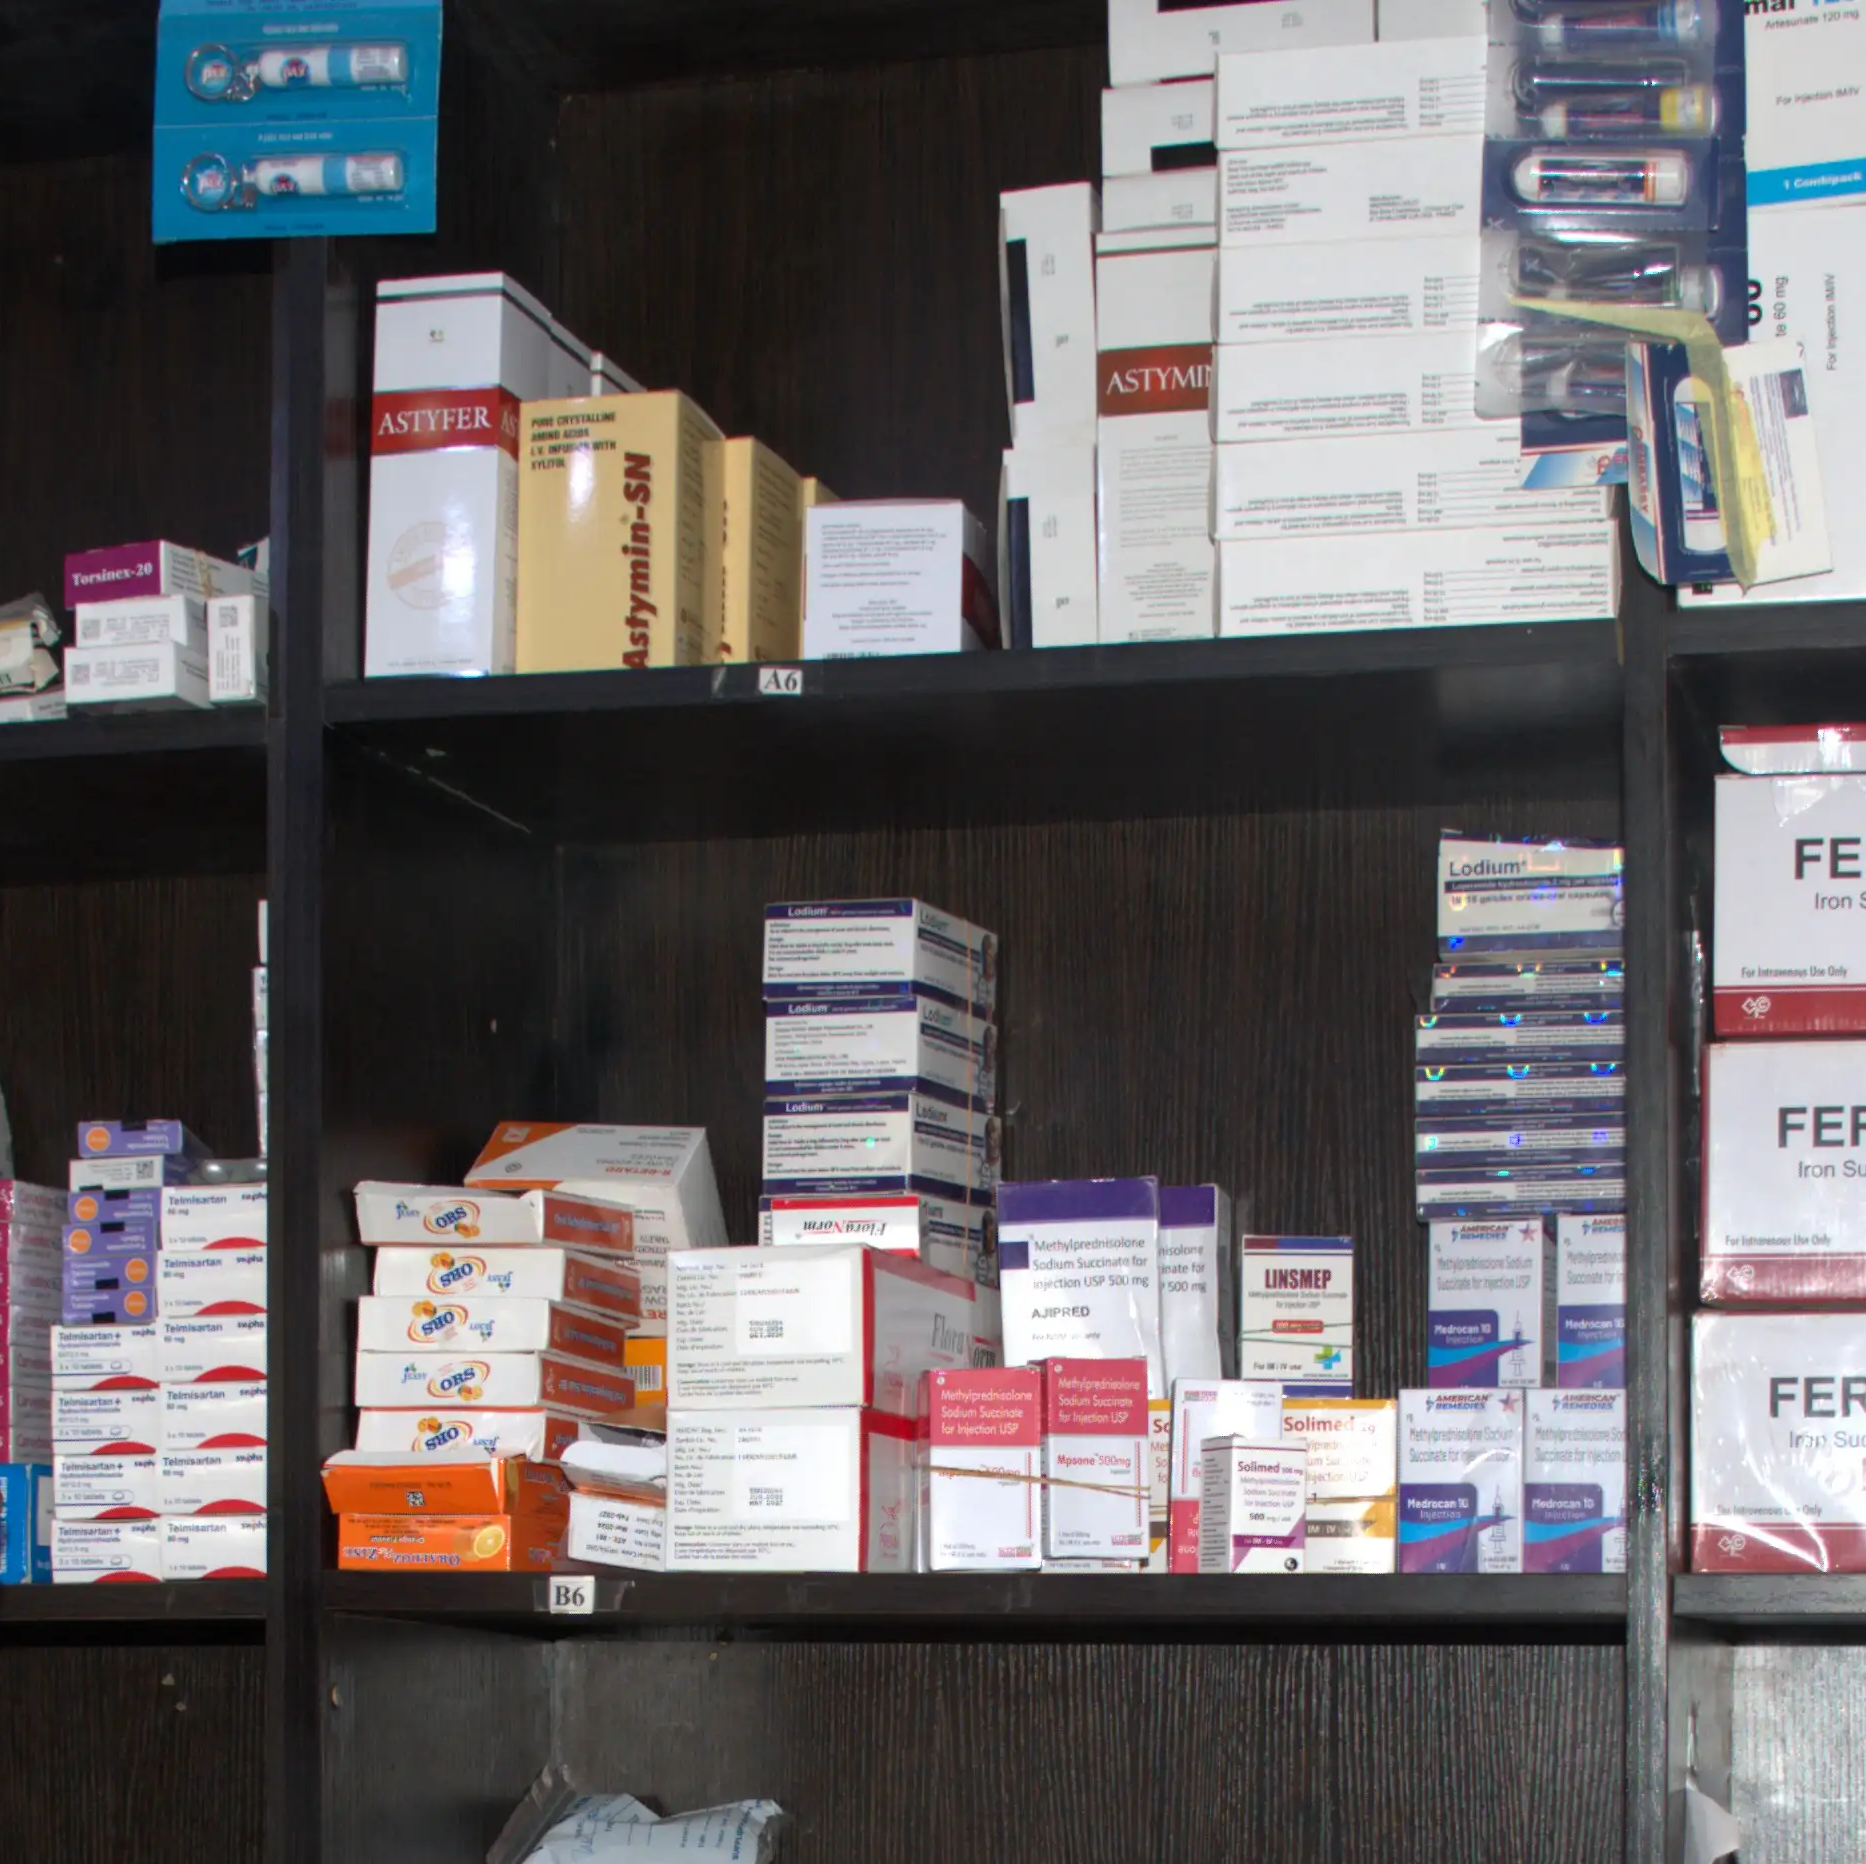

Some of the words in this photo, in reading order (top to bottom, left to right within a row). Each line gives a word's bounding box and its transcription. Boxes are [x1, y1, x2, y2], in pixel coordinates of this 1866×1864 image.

[377, 405, 491, 437] ASTYFER
[621, 451, 653, 670] Astymin-SN
[72, 562, 153, 586] Torsinex-20
[765, 670, 798, 692] A6
[1449, 859, 1521, 877] Lodium
[1814, 892, 1854, 910] Iron
[435, 1206, 467, 1229] ORS
[1035, 1237, 1145, 1253] Methylprednisolone
[1033, 1257, 1073, 1270] Sodium
[1076, 1255, 1129, 1269] Succinate
[1131, 1255, 1147, 1267] for
[1083, 1274, 1106, 1287] USP
[1108, 1273, 1129, 1286] 500
[1131, 1273, 1149, 1288] mg
[1264, 1270, 1331, 1290] LINSMEP
[1032, 1306, 1090, 1319] AJIPRED
[165, 1322, 223, 1333] Telmisartan
[163, 1456, 221, 1466] Telmisartan
[1098, 1454, 1131, 1467] 500mg
[1237, 1460, 1280, 1474] Solimed
[554, 1585, 585, 1606] B6
